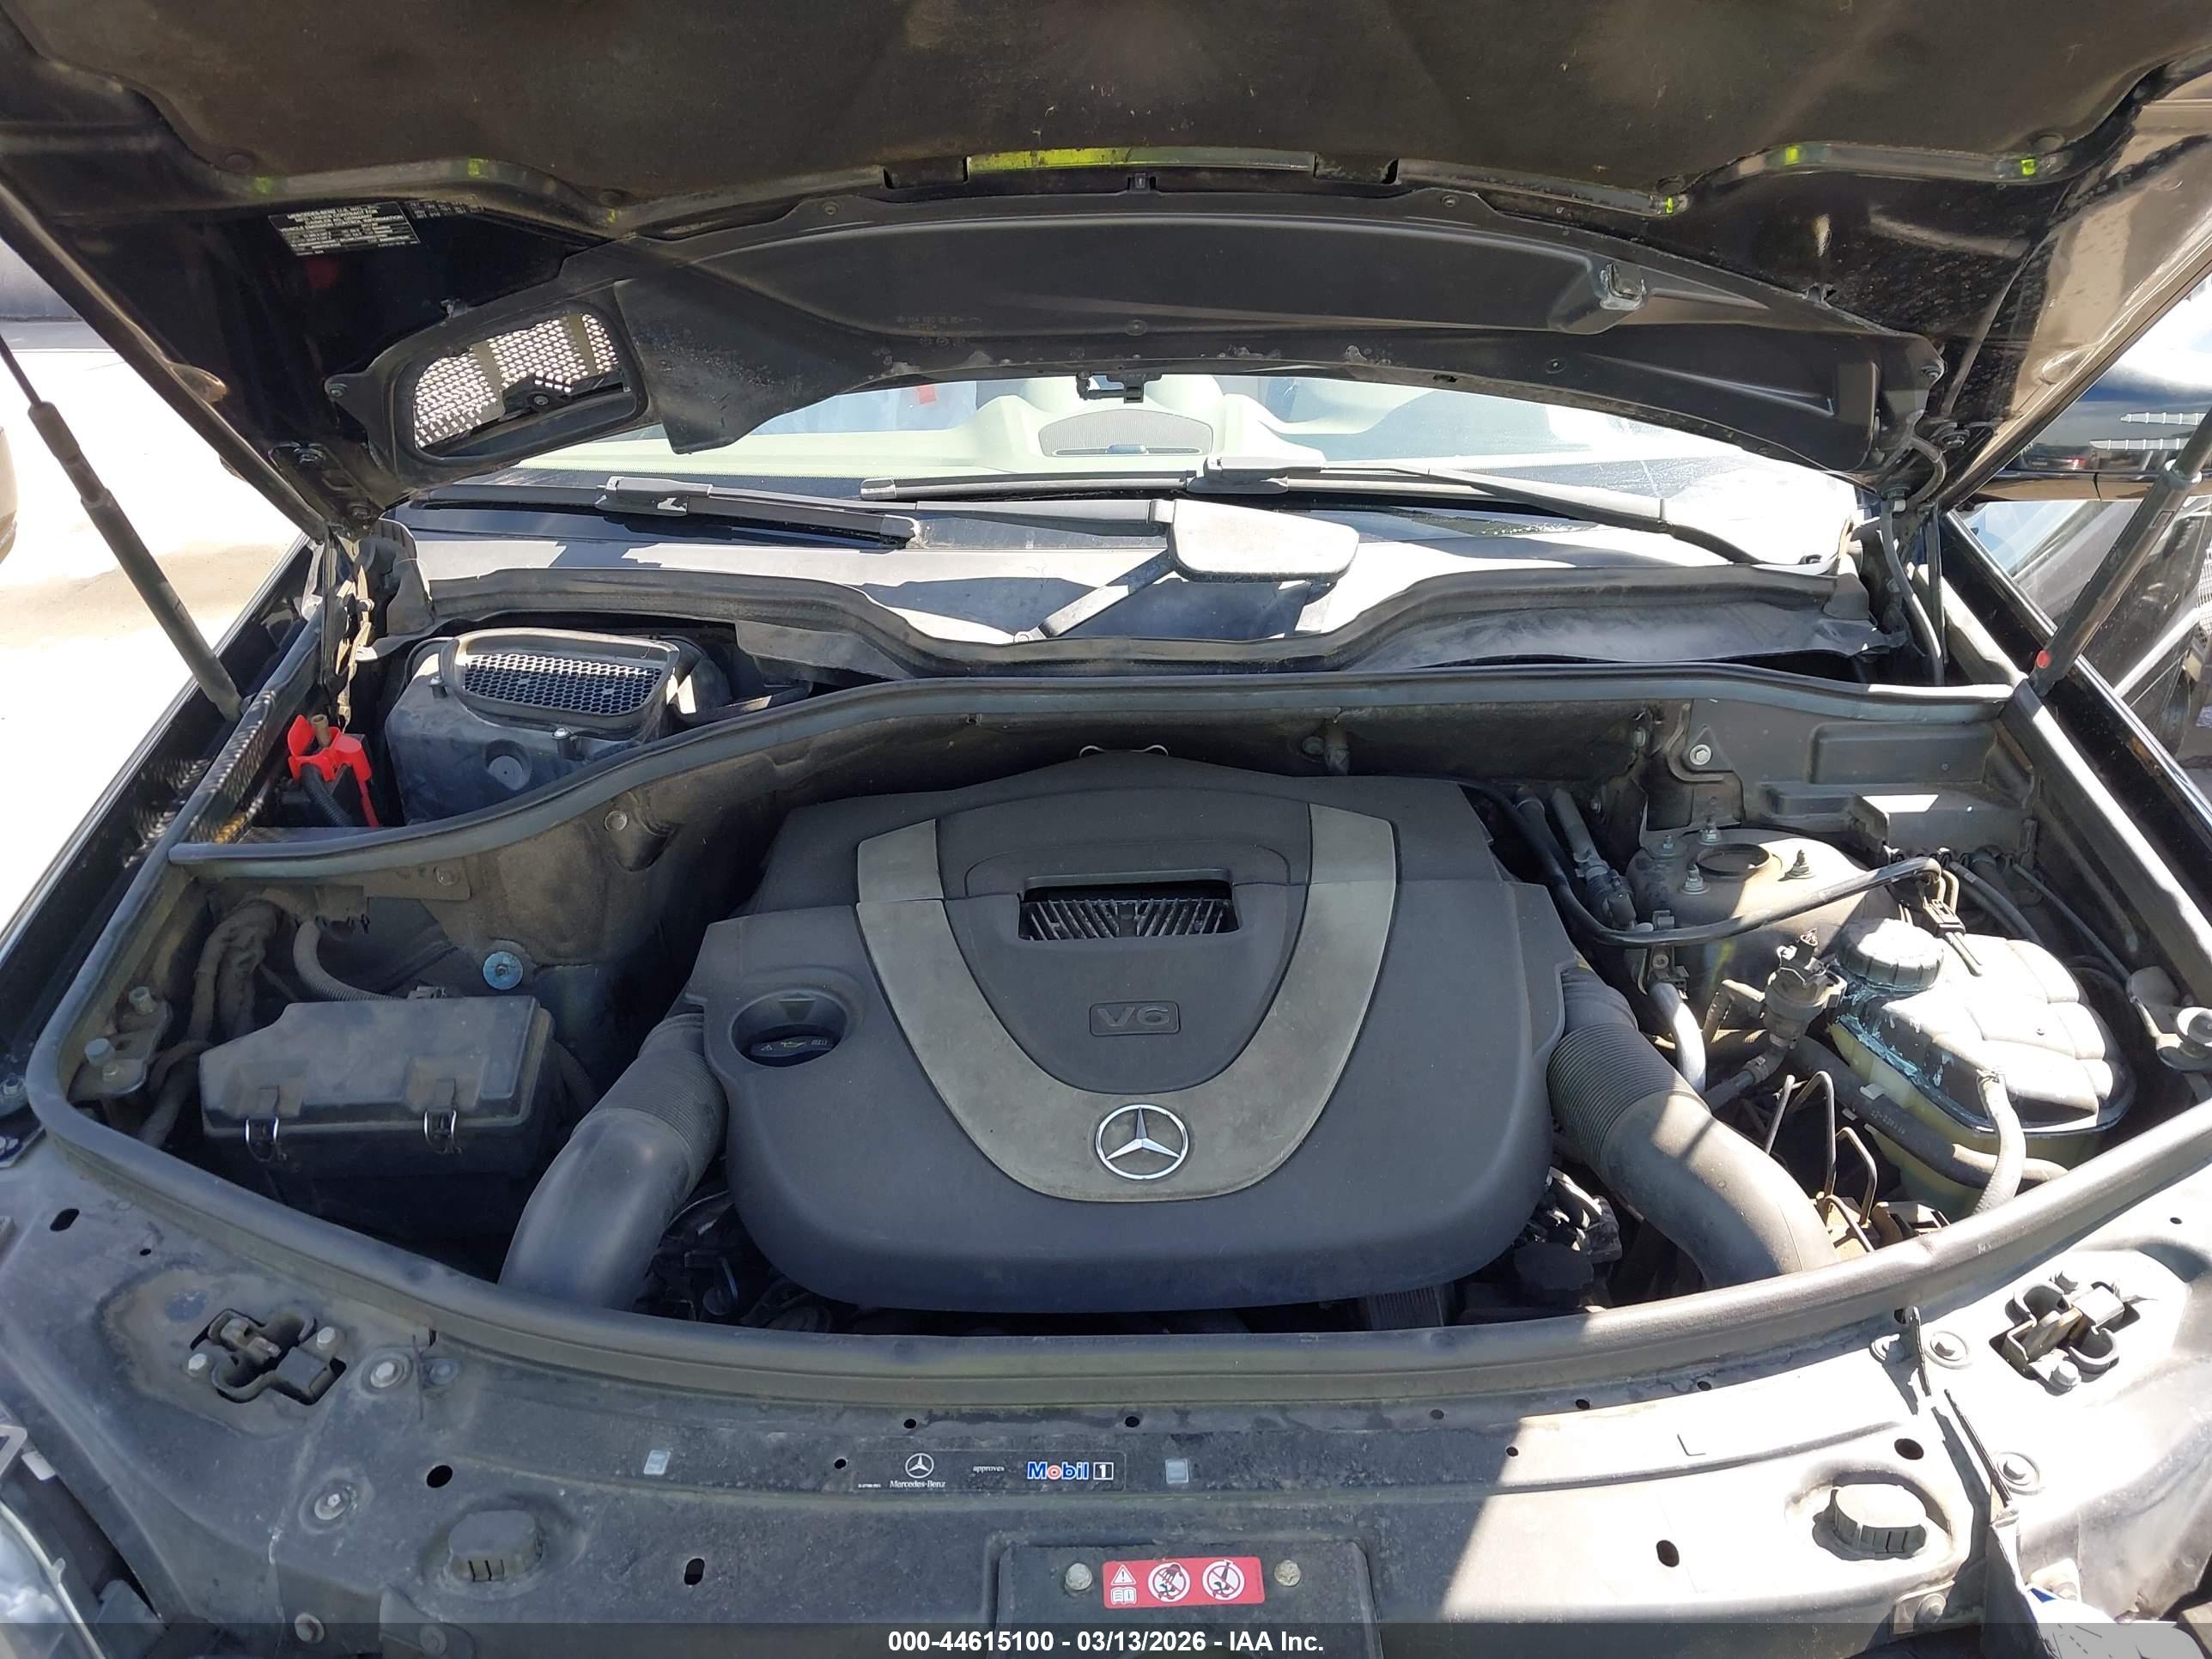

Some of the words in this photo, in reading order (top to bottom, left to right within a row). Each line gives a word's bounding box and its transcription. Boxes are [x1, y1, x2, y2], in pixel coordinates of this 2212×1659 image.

[363, 215, 404, 223] INFORMATION
[1097, 1006, 1169, 1026] V6
[973, 1463, 1005, 1474] approves
[1027, 1462, 1089, 1480] Mobil
[890, 1480, 945, 1488] Mercedes-Benz
